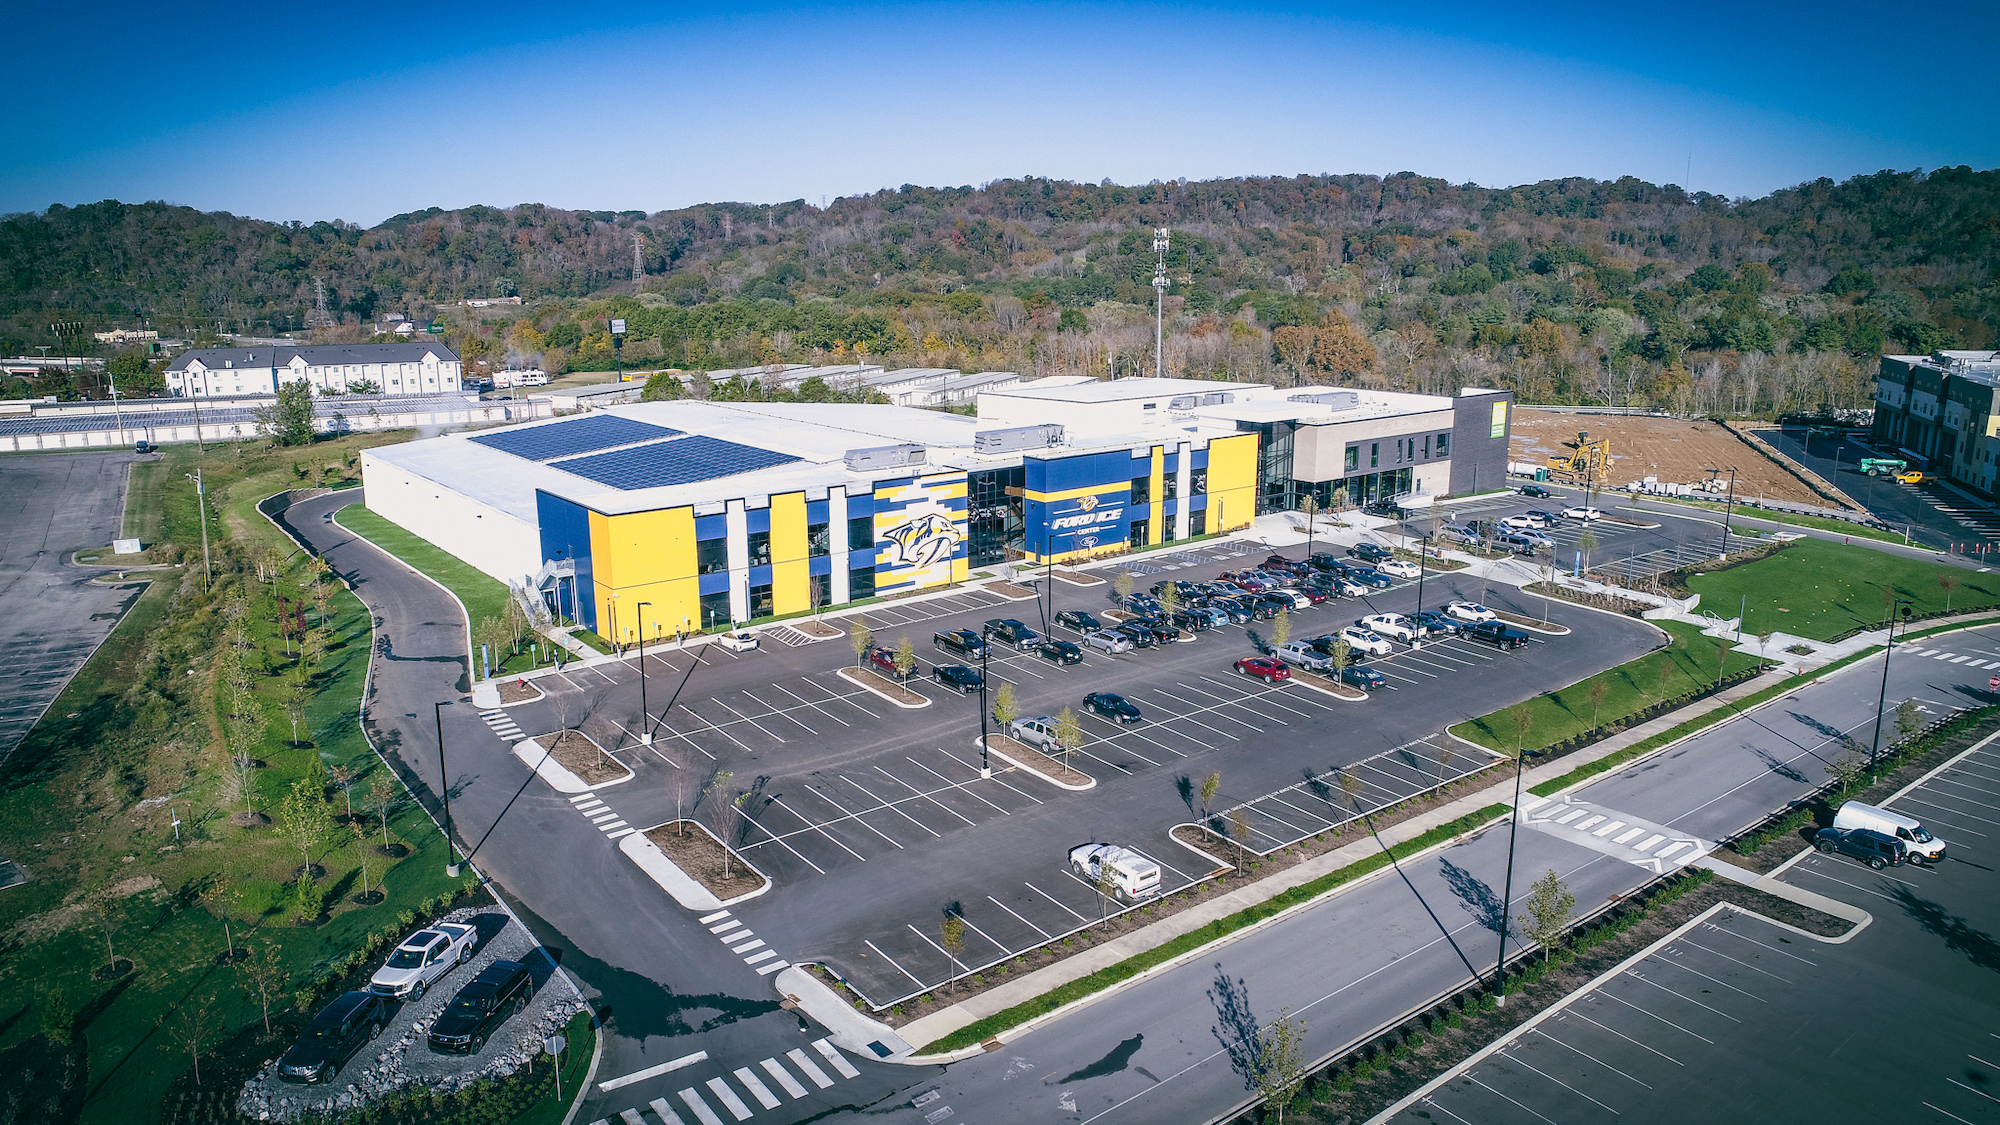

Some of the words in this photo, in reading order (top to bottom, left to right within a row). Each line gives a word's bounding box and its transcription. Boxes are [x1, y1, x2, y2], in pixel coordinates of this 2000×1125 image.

[1051, 513, 1096, 530] FORD
[1096, 508, 1123, 523] ICE
[1077, 526, 1100, 535] CENTER
